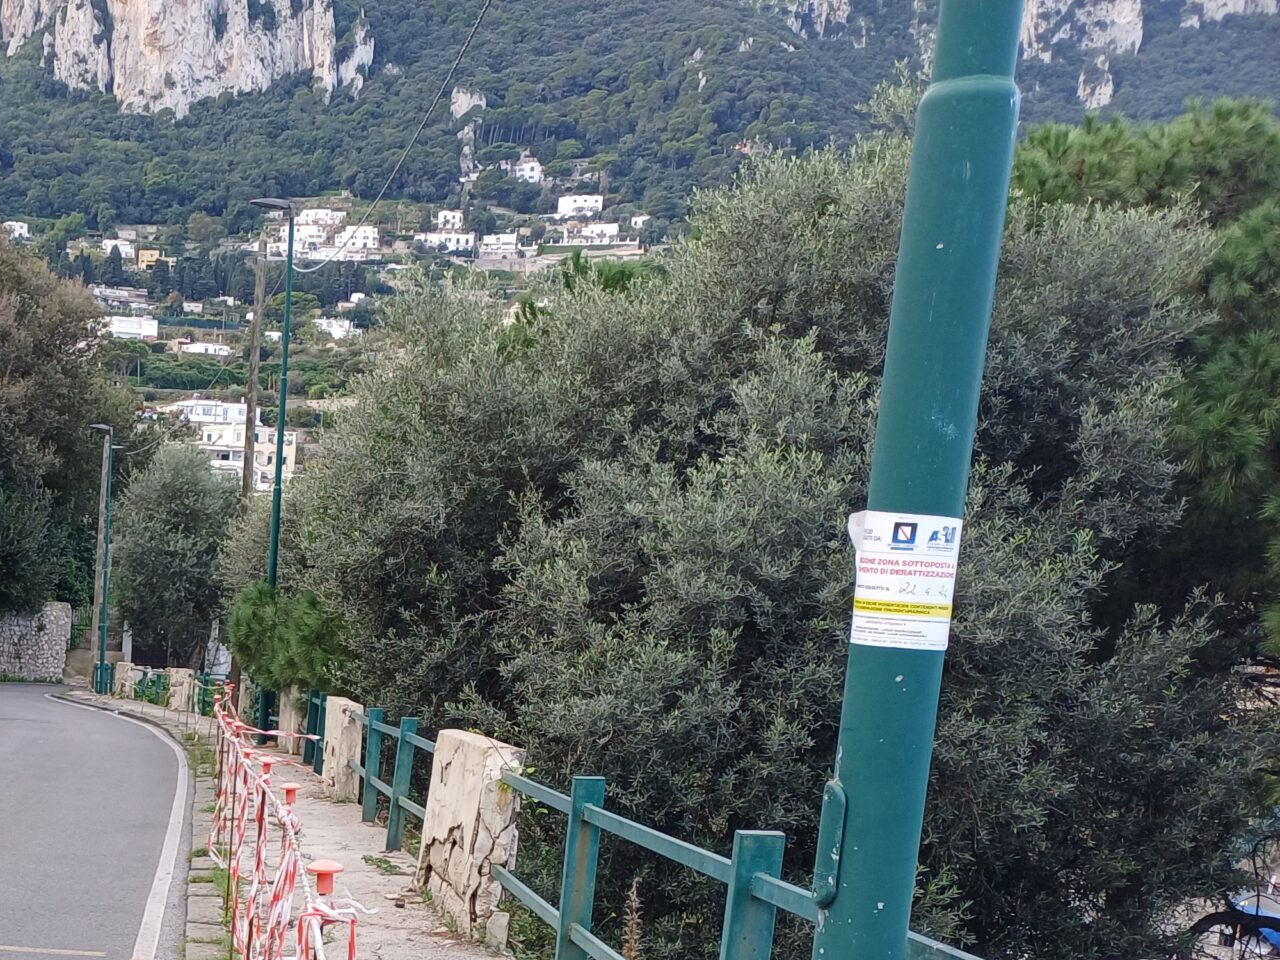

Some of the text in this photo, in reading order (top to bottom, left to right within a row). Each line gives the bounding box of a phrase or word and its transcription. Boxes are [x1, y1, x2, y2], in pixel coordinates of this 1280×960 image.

[877, 558, 900, 567] ZONA
[901, 560, 951, 569] SOTTOPOSTA
[880, 567, 888, 575] DI
